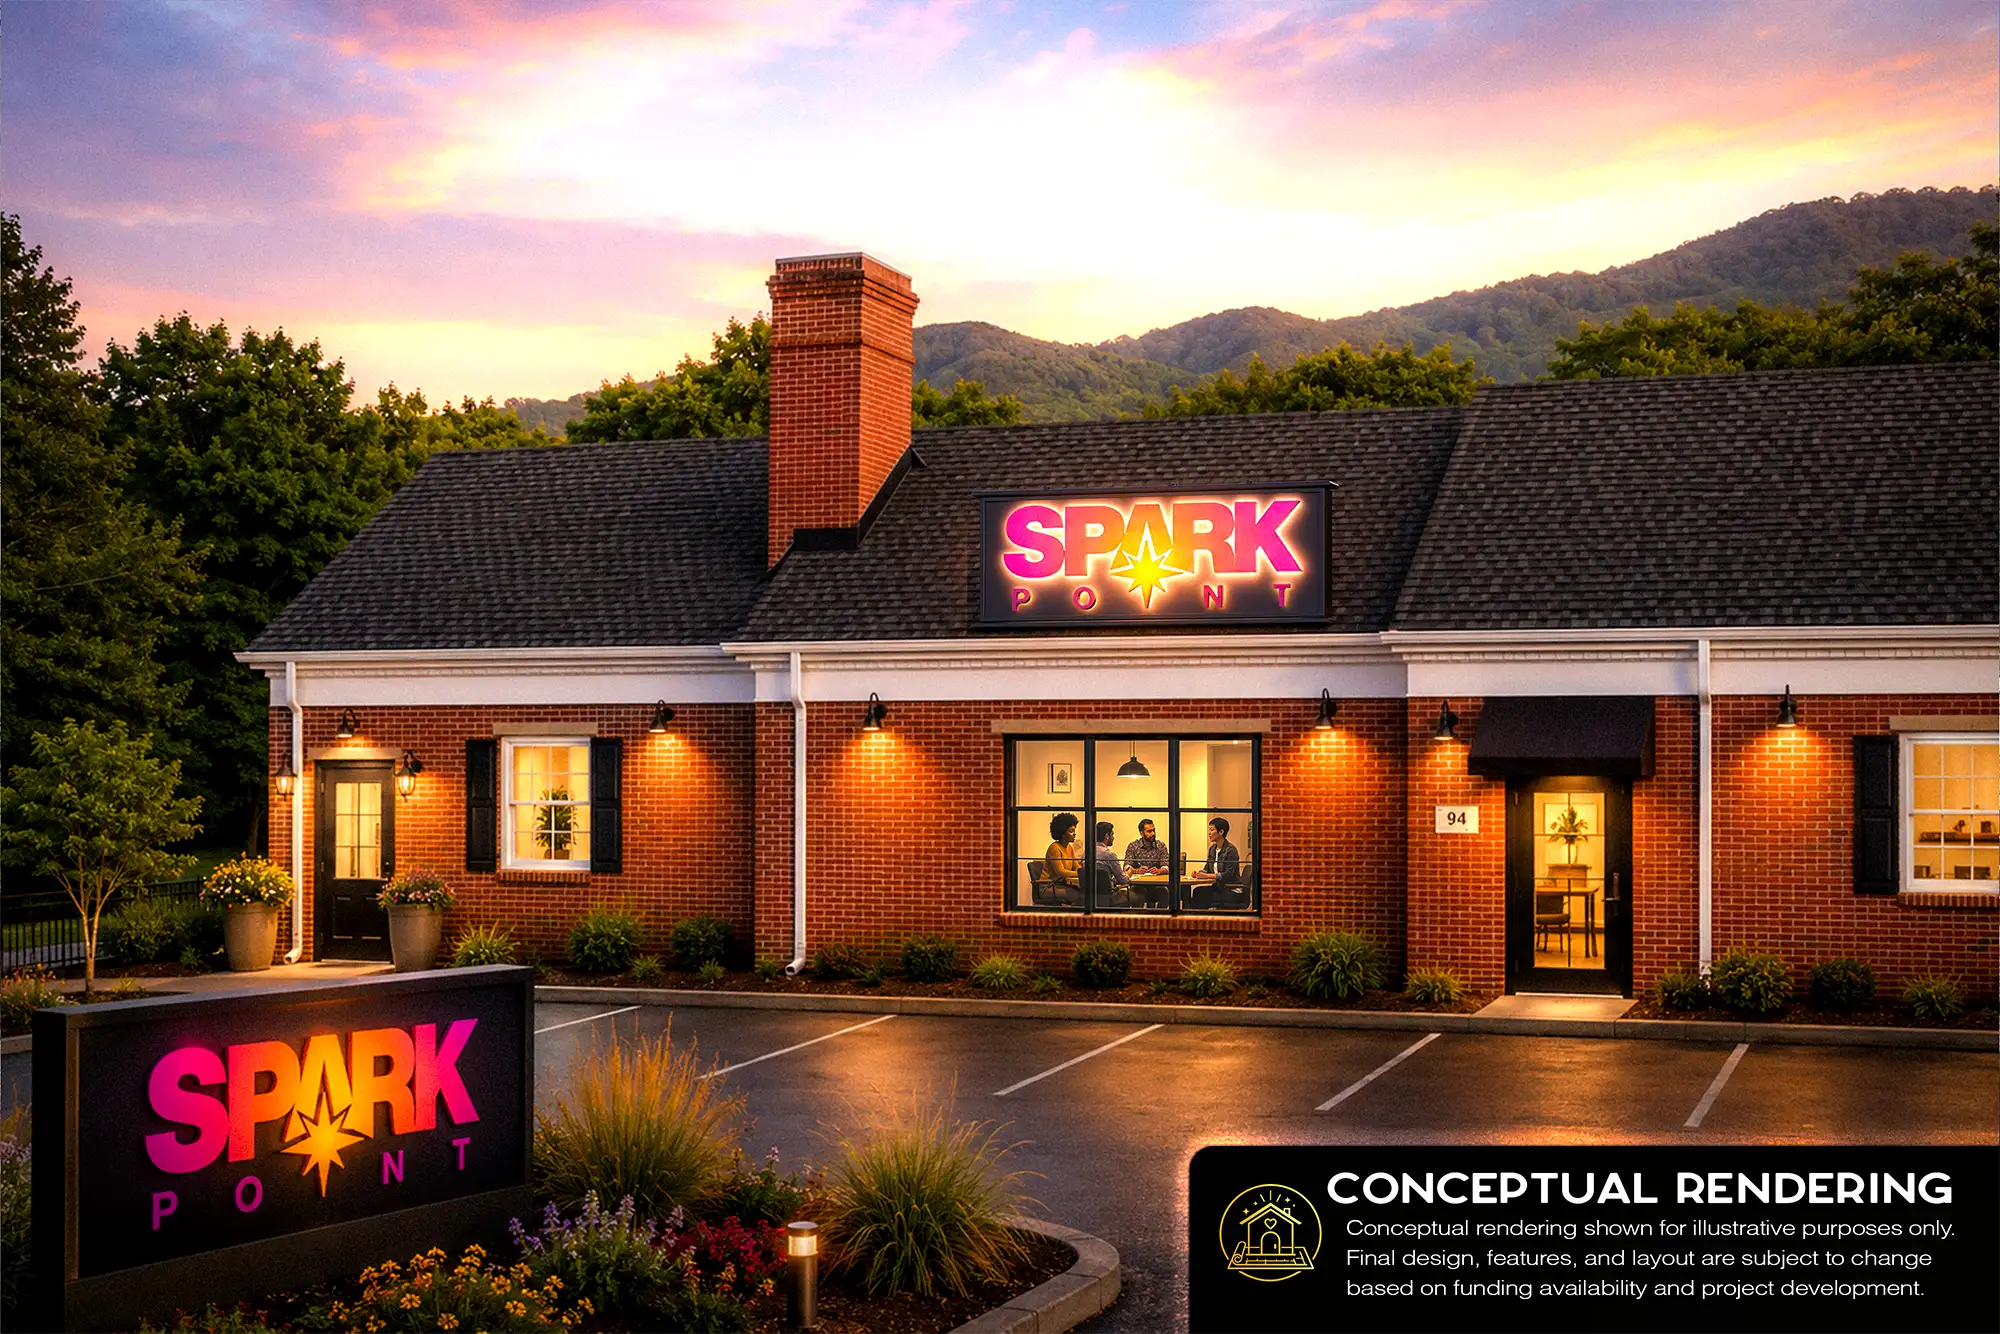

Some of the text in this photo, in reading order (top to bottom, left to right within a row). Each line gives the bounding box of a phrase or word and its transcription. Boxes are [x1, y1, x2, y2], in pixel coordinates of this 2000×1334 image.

[1002, 500, 1303, 578] SPARK
[1011, 583, 1291, 612] PONT
[1447, 811, 1466, 826] 94
[145, 1018, 480, 1174] SPARK
[151, 1136, 472, 1231] PONT
